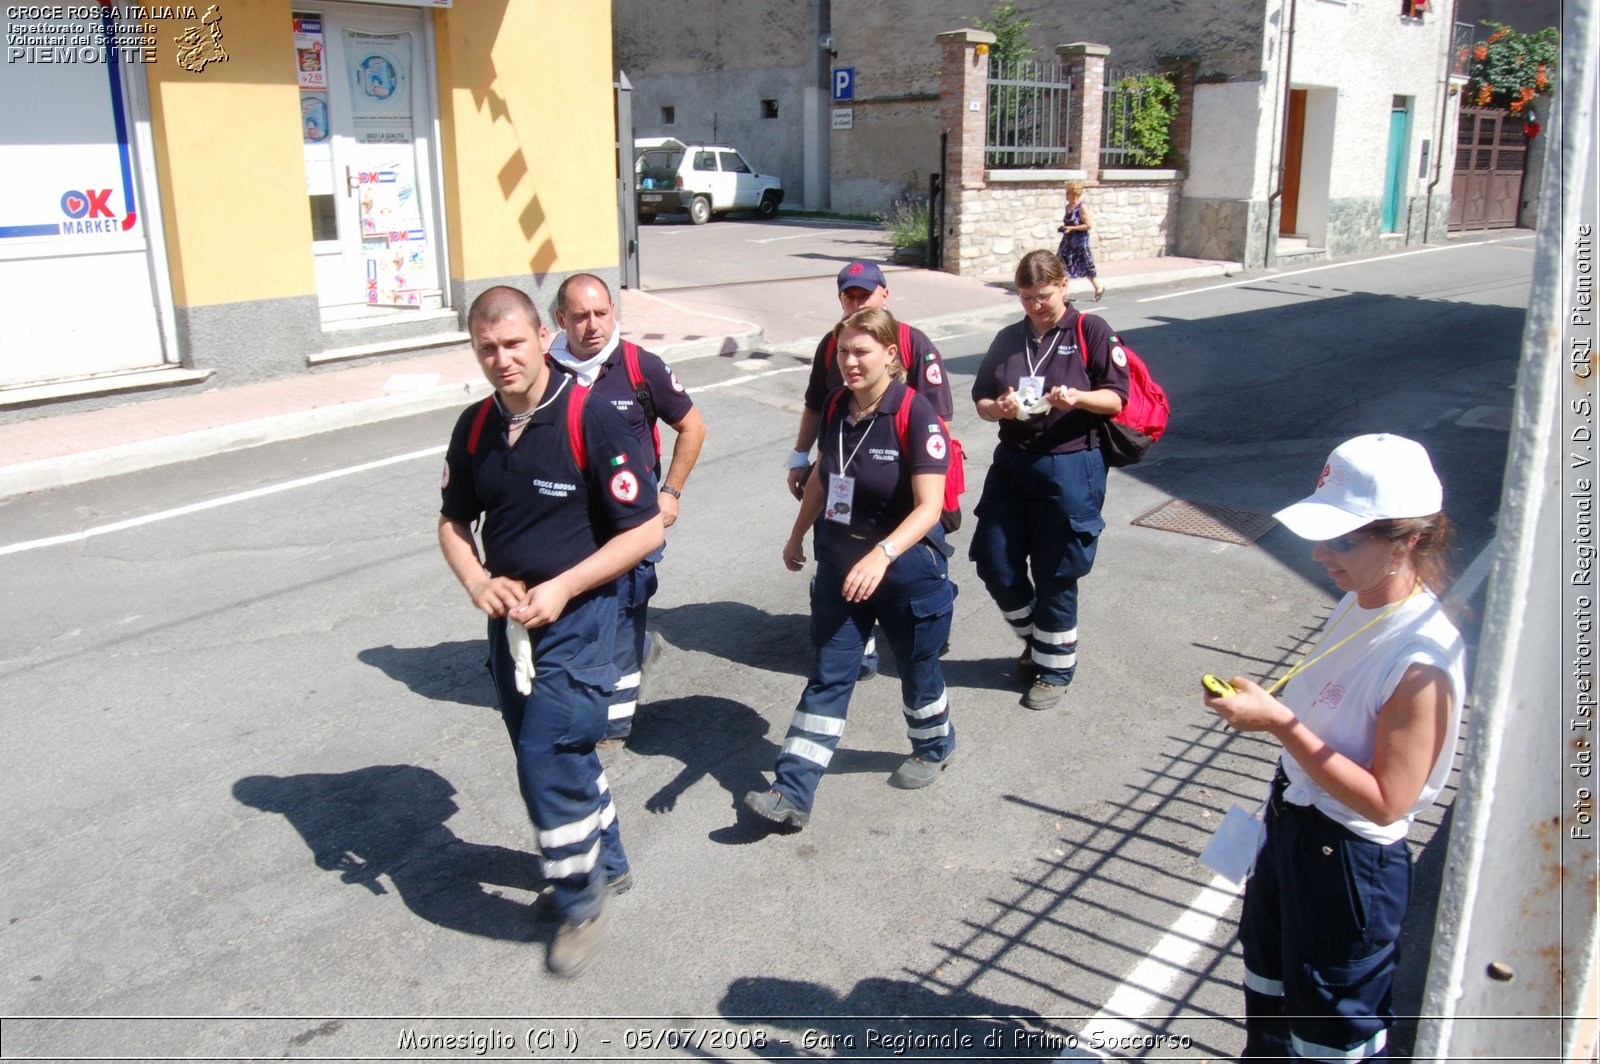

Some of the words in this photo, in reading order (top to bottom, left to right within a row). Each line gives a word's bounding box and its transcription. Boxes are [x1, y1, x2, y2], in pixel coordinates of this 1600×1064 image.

[836, 71, 850, 97] P
[61, 189, 116, 219] OK
[63, 219, 118, 235] MARKET
[533, 479, 553, 489] CROCE
[553, 483, 576, 491] ROSSA
[538, 488, 568, 498] ITALIANA
